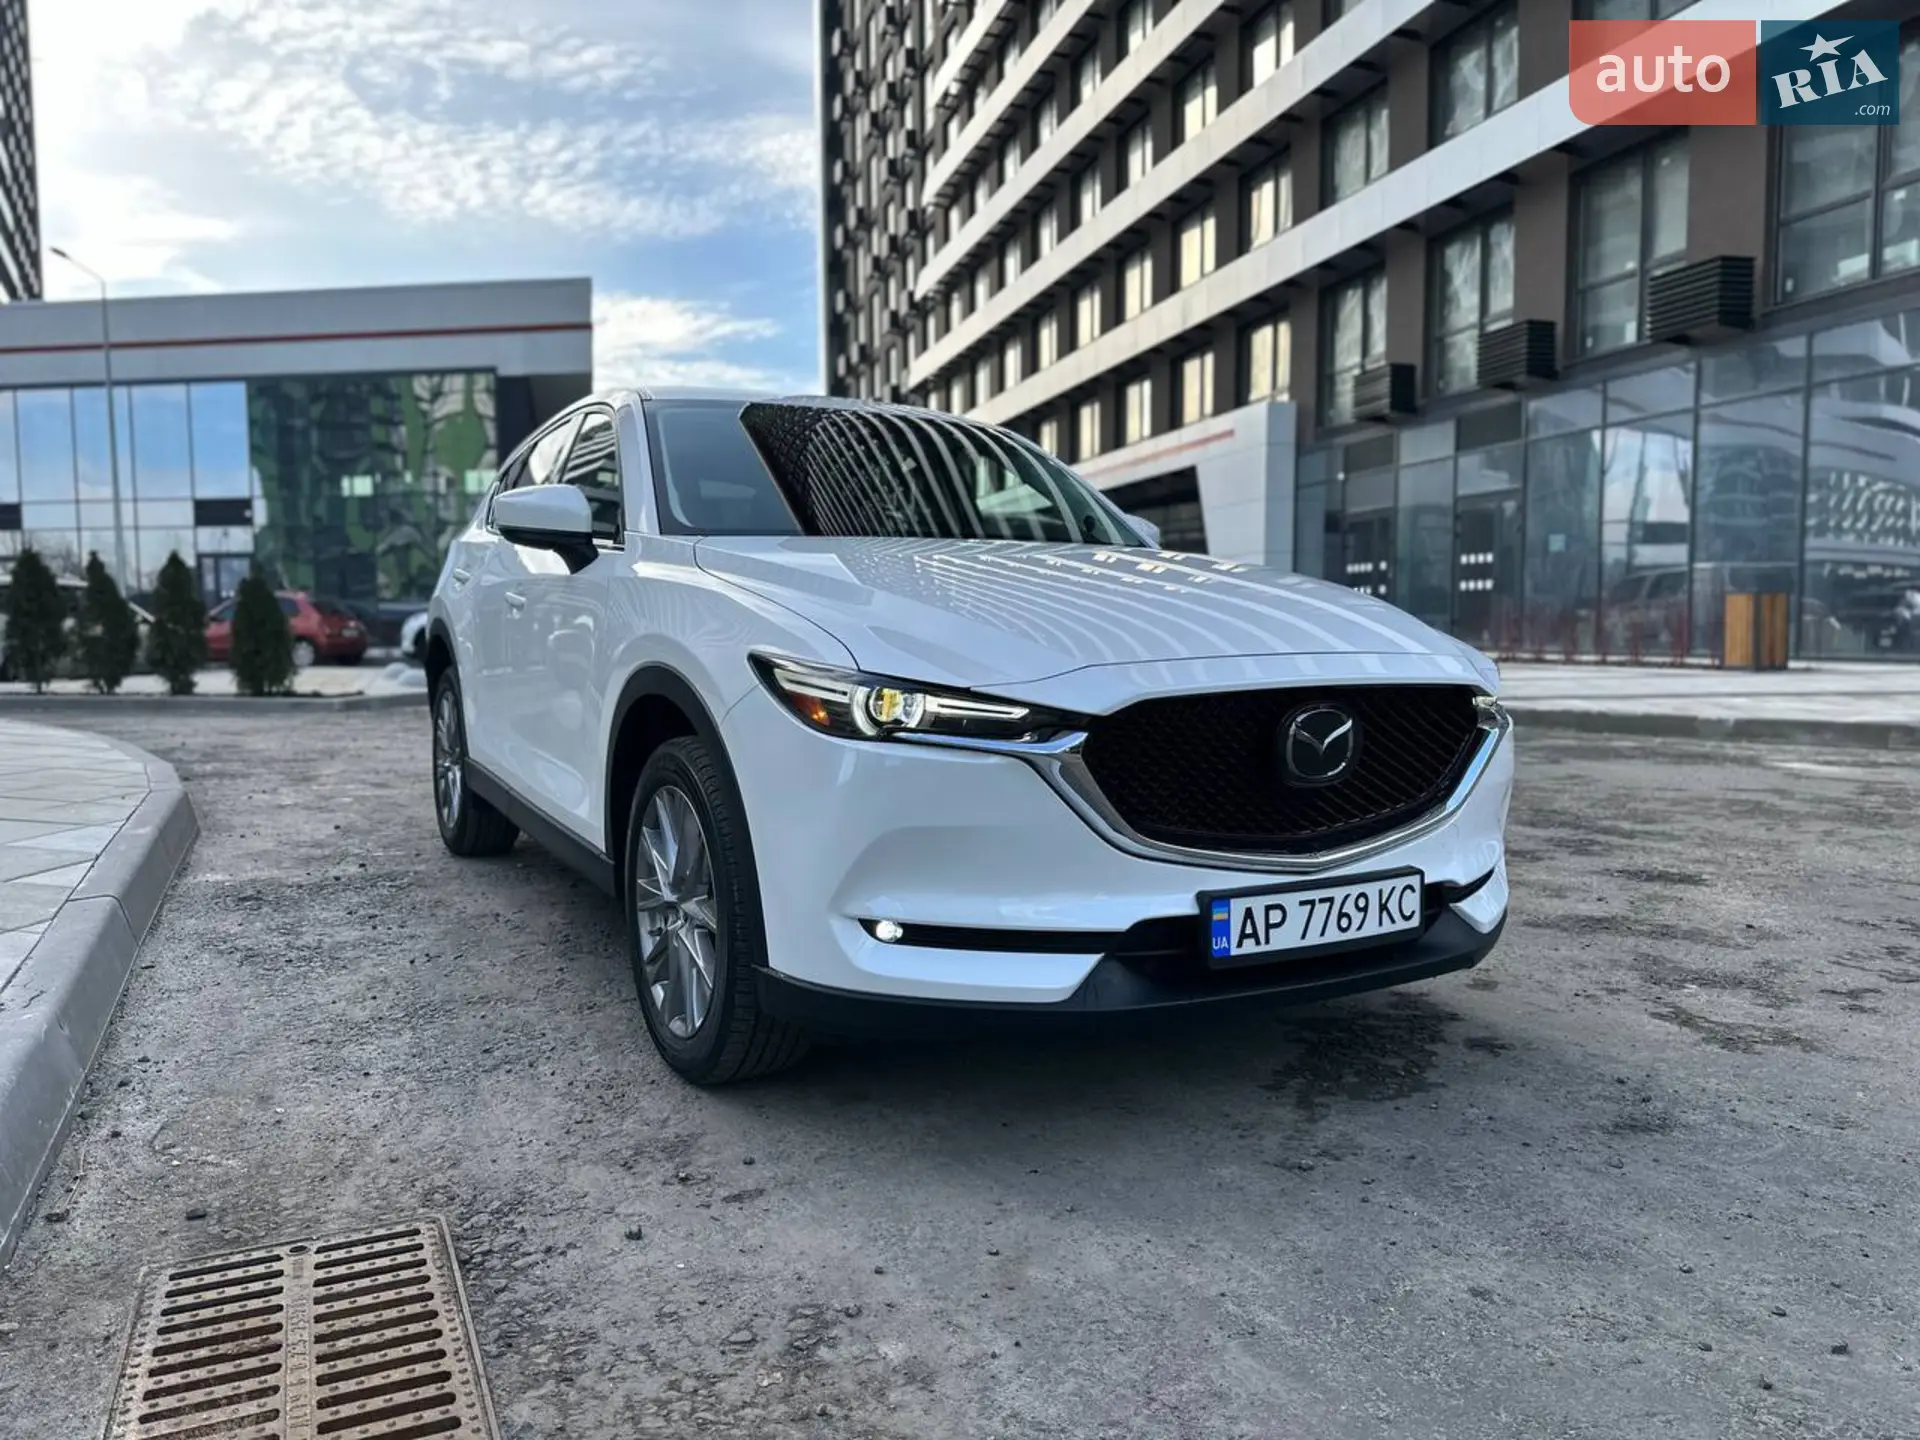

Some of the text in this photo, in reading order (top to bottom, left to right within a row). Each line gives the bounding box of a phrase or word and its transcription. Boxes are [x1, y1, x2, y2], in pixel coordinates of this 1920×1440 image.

[1236, 884, 1417, 949] AP 7769 KC
[1212, 936, 1229, 950] UA
